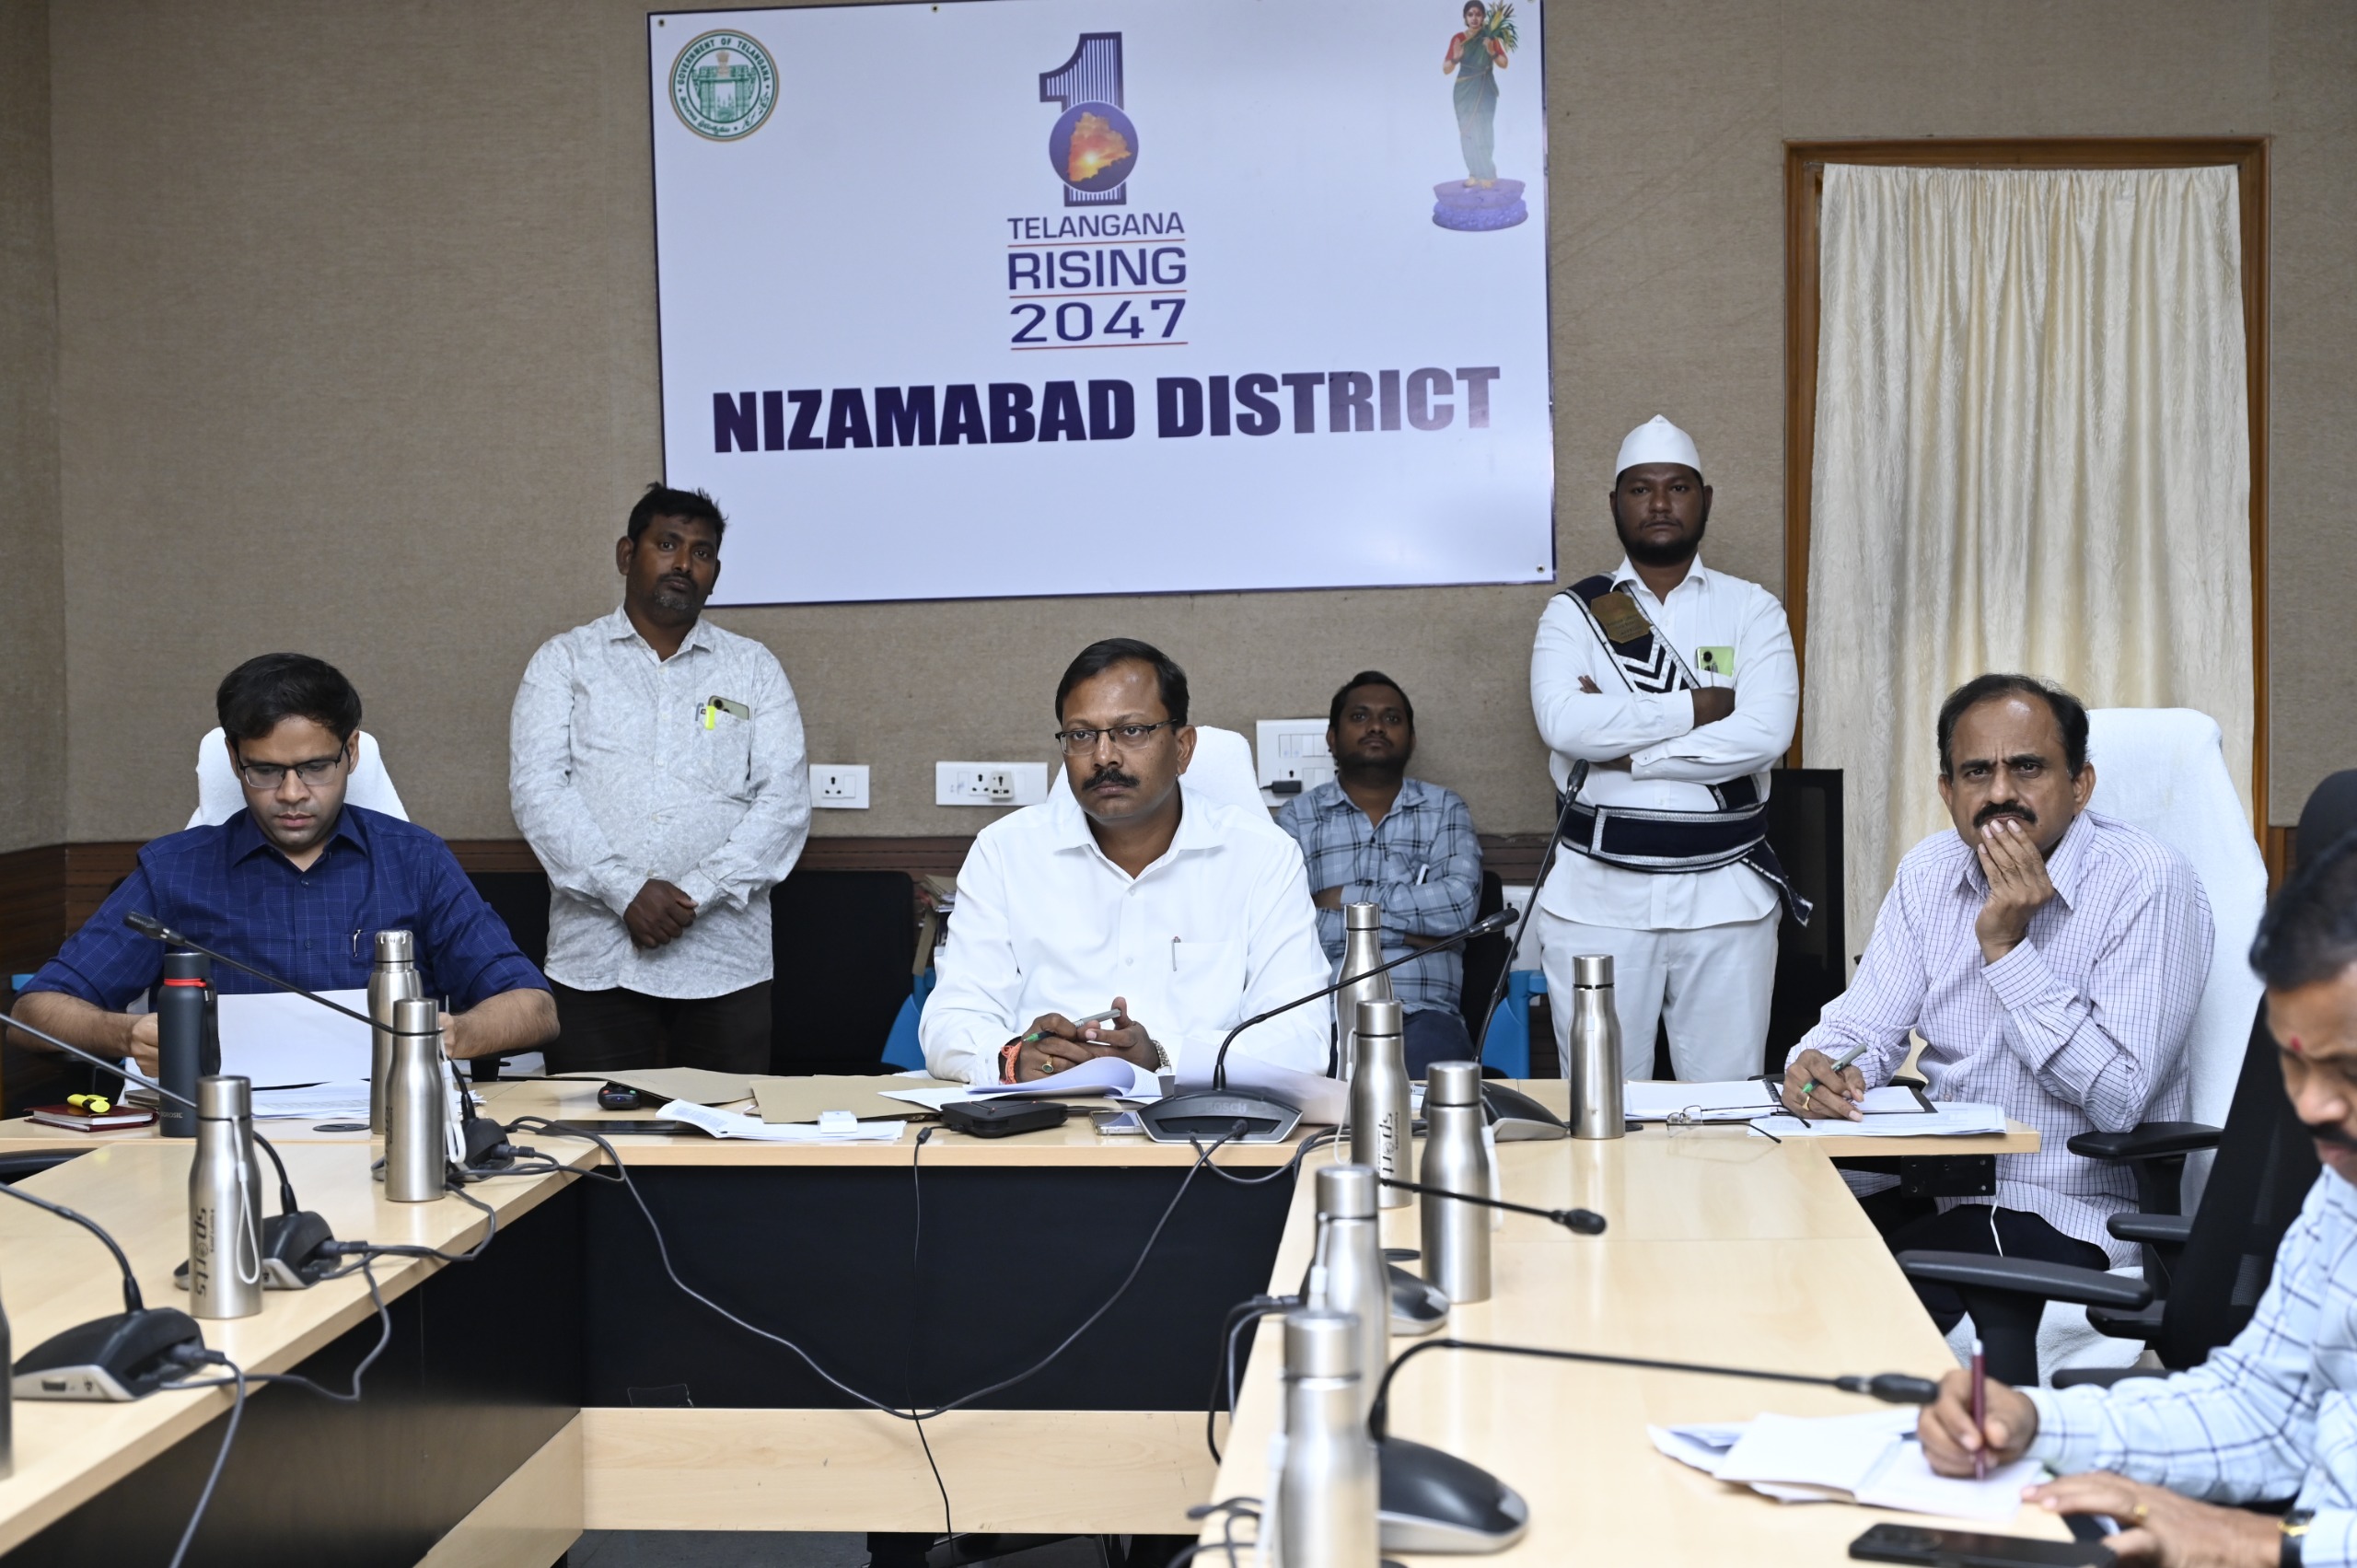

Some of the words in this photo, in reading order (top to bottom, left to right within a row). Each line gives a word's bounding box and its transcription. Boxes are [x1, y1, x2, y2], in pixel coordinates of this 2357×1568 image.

[677, 39, 715, 85] GOVERNMENT
[721, 37, 732, 46] OF
[737, 40, 772, 83] TELANGANA
[1007, 212, 1185, 239] TELANGANA
[1008, 247, 1187, 290] RISING
[1010, 298, 1187, 343] 2047
[713, 379, 1135, 453] NIZAMABAD
[1156, 366, 1501, 438] DISTRICT
